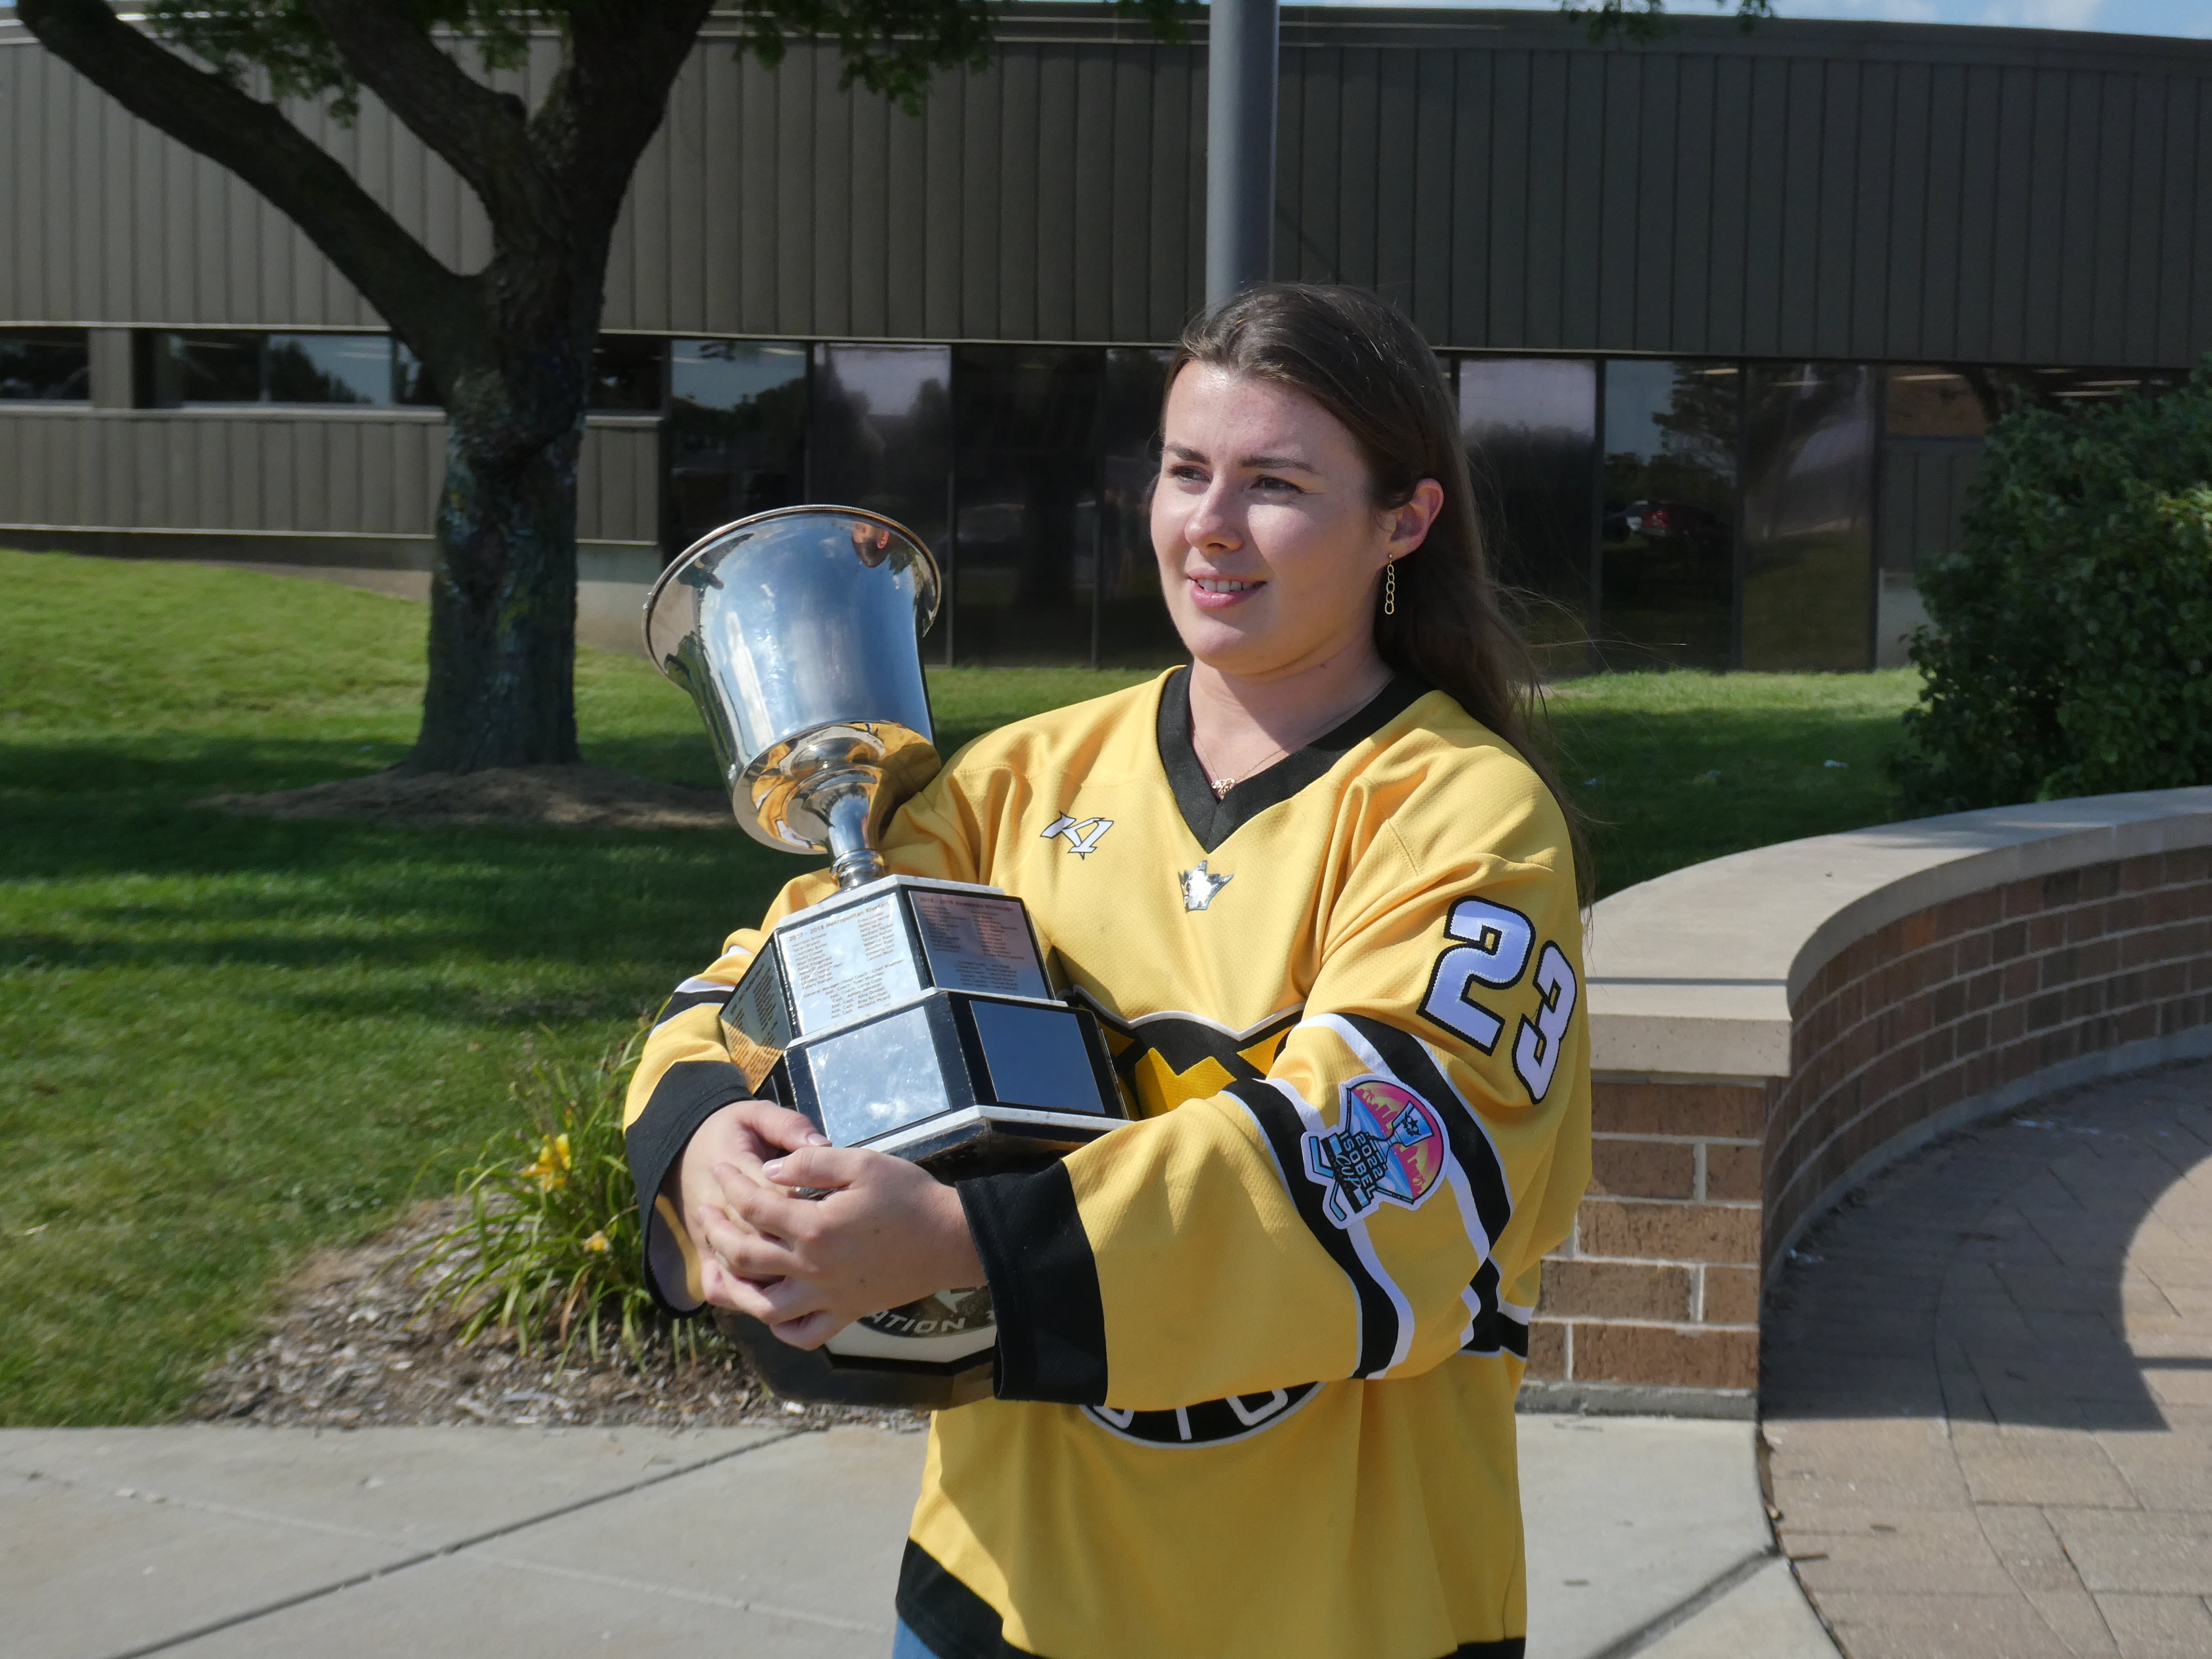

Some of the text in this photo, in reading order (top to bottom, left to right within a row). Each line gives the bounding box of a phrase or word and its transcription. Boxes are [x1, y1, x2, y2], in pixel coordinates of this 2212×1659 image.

[810, 925, 824, 933] 2018
[826, 910, 864, 927] Metropolitan
[863, 982, 881, 991] Johnston
[1416, 896, 1578, 1105] 23
[1340, 1133, 1375, 1198] ISOBEL
[1355, 1133, 1383, 1179] 2022
